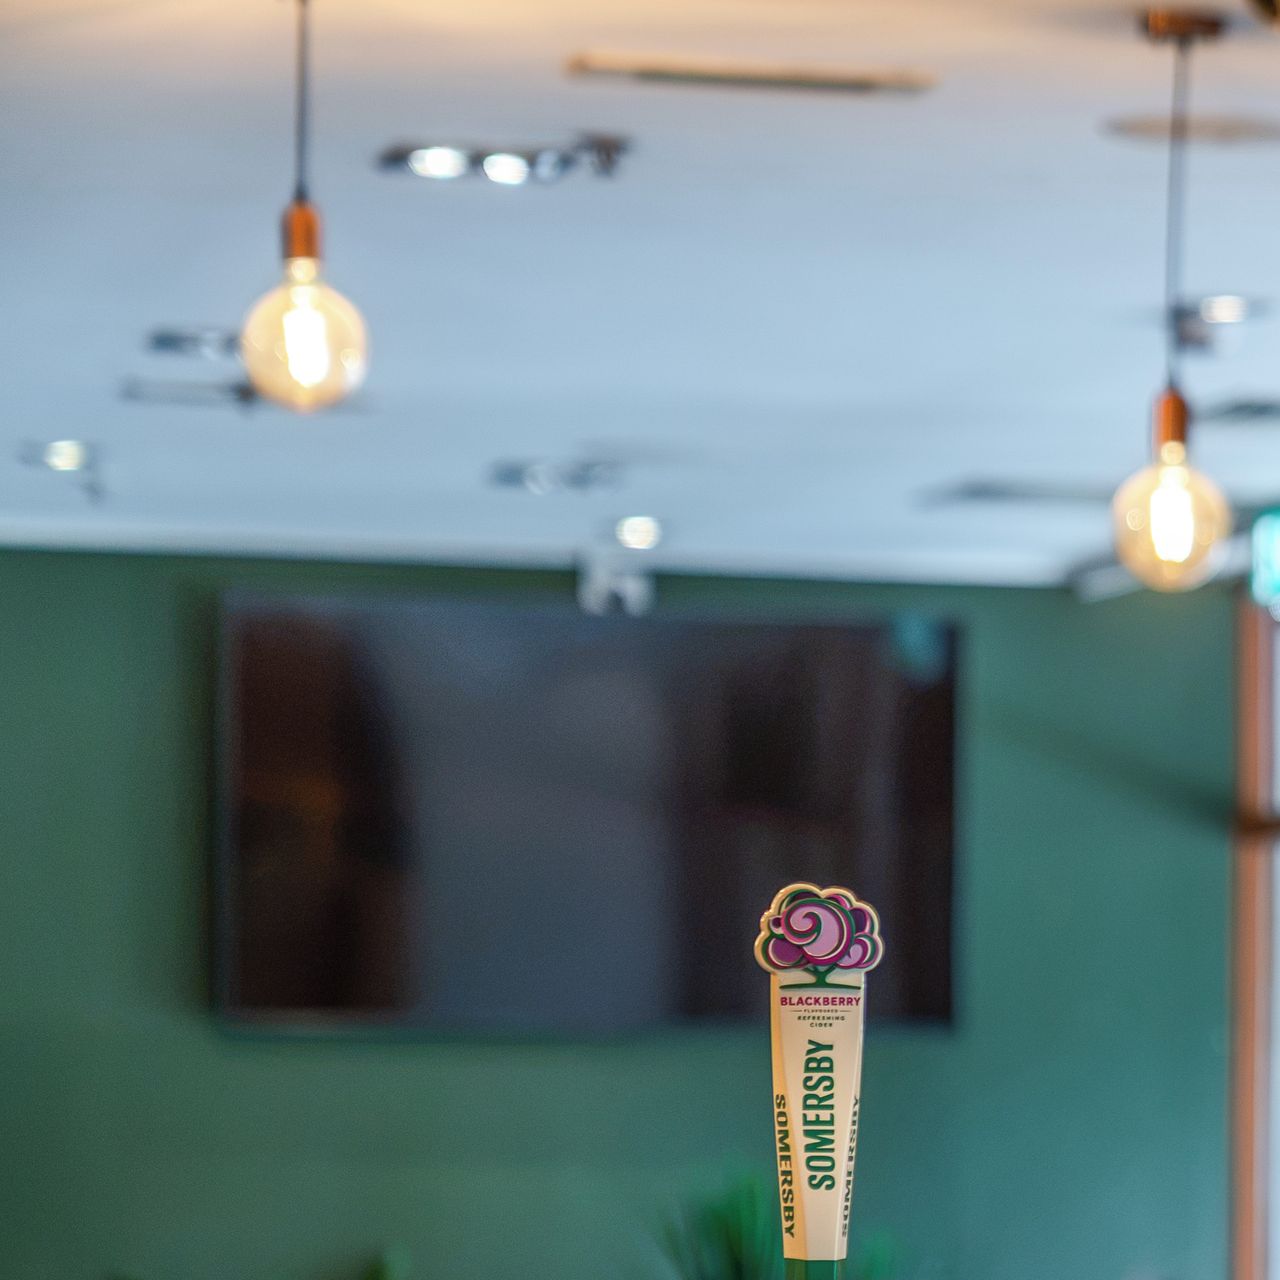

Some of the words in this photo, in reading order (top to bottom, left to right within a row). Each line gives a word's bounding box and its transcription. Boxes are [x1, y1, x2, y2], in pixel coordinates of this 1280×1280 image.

[780, 996, 862, 1006] BLACKBERRY
[775, 1094, 796, 1239] SOMERSBY
[802, 1039, 836, 1191] SOMERSBY
